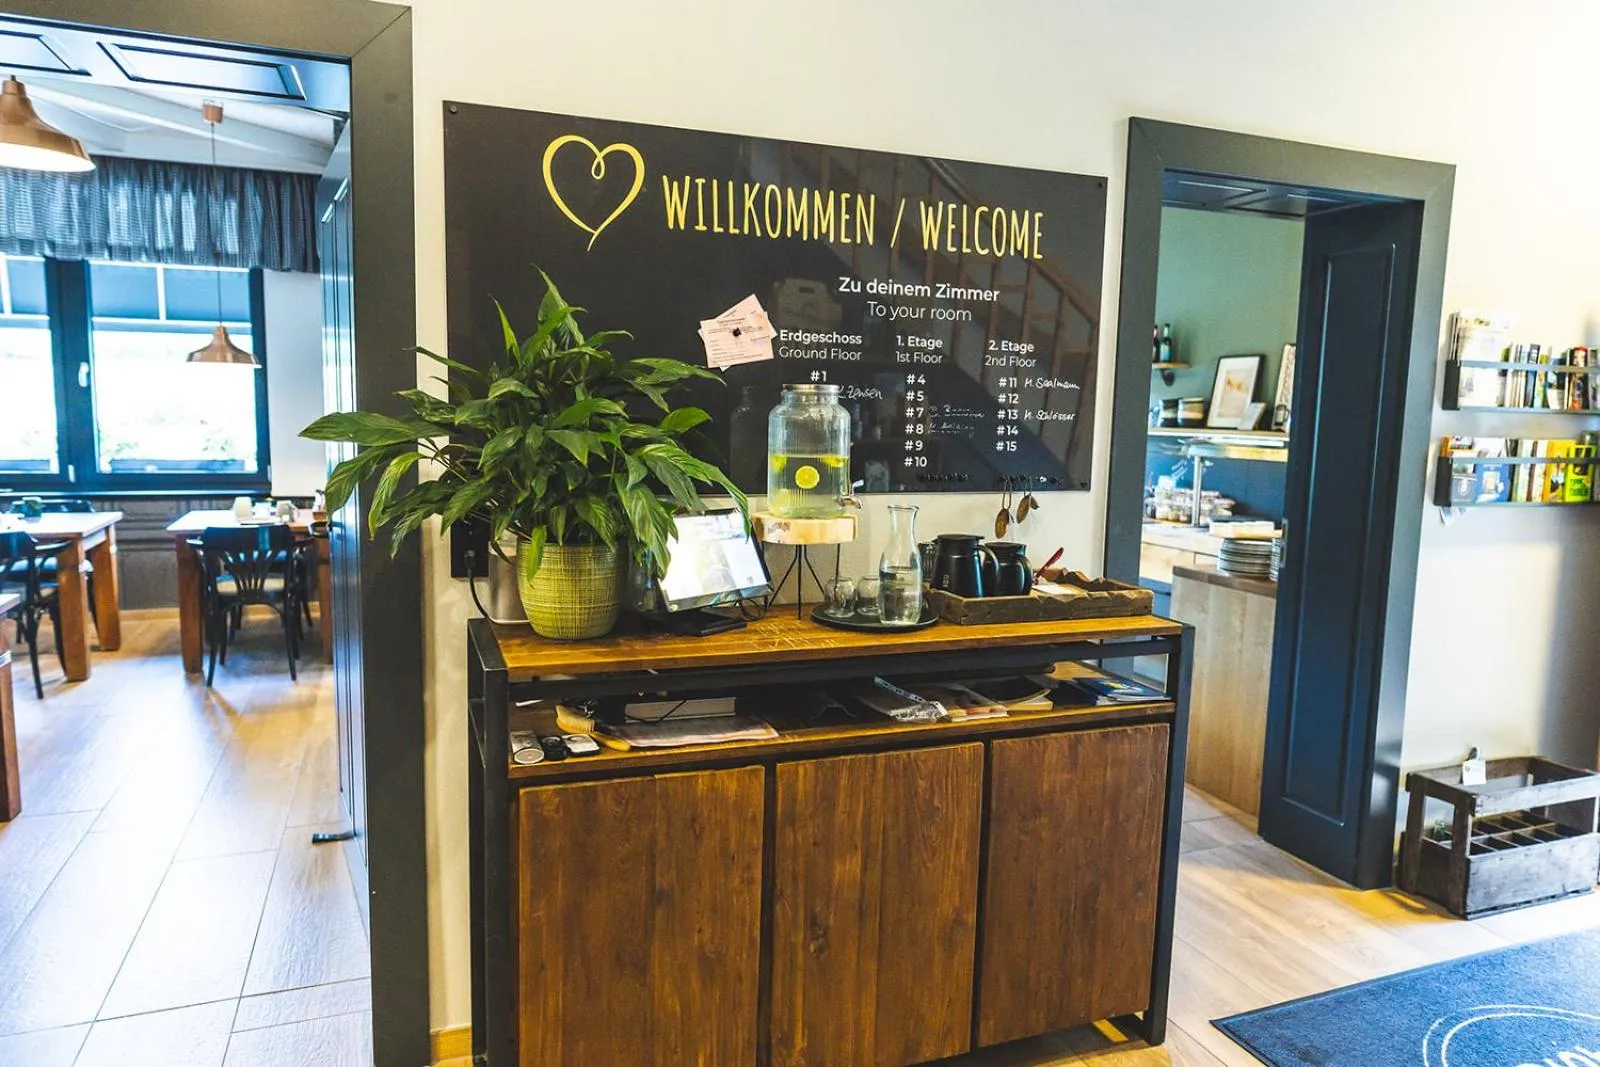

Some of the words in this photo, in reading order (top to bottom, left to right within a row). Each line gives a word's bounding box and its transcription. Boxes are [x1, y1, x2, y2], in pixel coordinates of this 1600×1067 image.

[661, 174, 876, 246] WILLKOMMEN
[890, 198, 906, 248] /
[920, 201, 1044, 260] WELCOME
[838, 277, 862, 293] Zu
[866, 278, 931, 297] deinem
[935, 283, 1000, 302] Zimmer
[867, 301, 887, 317] To
[889, 305, 926, 321] your
[930, 308, 972, 321] room
[779, 330, 862, 345] Erdgeschoss
[896, 335, 905, 347] 1.
[907, 336, 943, 351] Etage
[778, 346, 828, 361] Ground
[830, 348, 862, 361] Floor
[988, 340, 999, 351] 2.
[1001, 341, 1035, 355] Etage
[896, 351, 910, 363] 1st
[913, 352, 943, 364] Floor
[985, 355, 1007, 367] 2nd
[1009, 356, 1037, 368] Floor
[810, 370, 828, 382] #1
[906, 373, 927, 385] #4
[998, 377, 1018, 388] #11
[905, 390, 925, 402] #5
[997, 393, 1020, 404] #12
[905, 407, 925, 418] #7
[997, 409, 1019, 420] #13
[904, 423, 924, 435] #8
[996, 425, 1019, 436] #14
[904, 440, 924, 451] #9
[995, 441, 1018, 452] #15
[903, 456, 928, 468] #10
